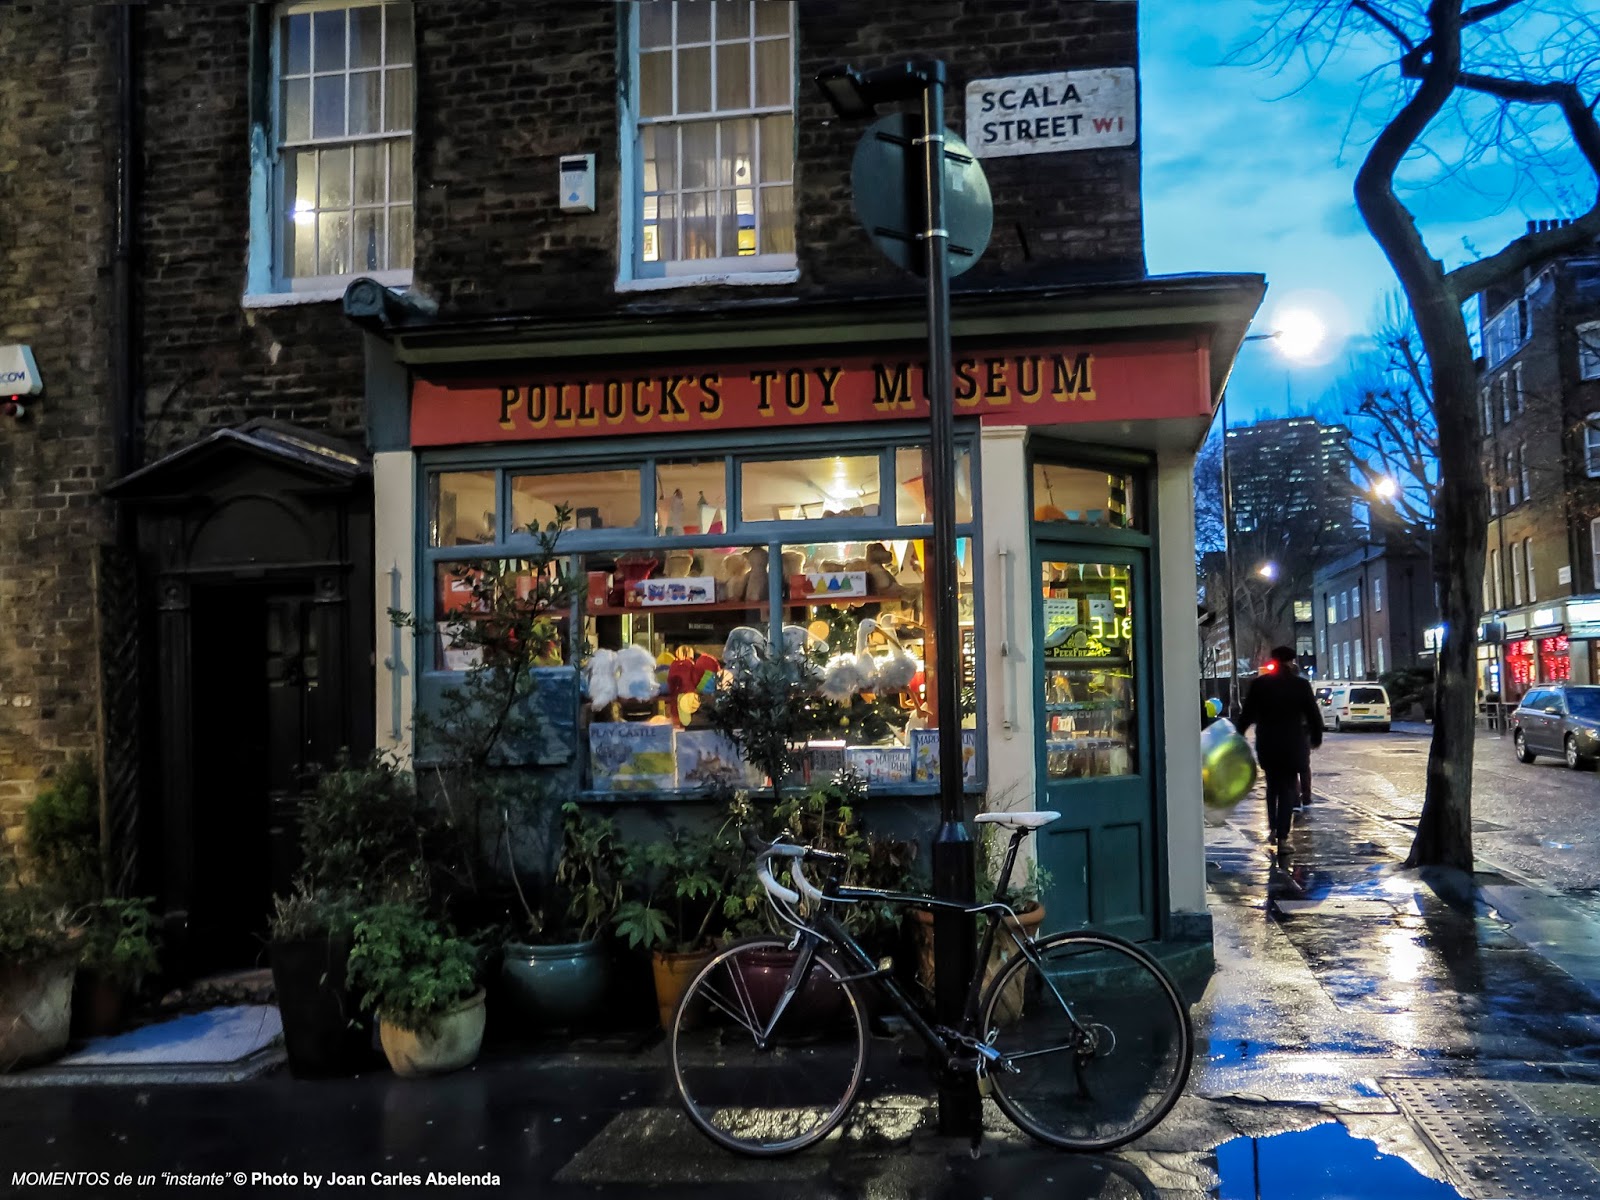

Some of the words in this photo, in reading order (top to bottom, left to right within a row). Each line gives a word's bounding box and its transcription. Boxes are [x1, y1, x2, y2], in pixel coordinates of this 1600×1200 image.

[981, 83, 1082, 112] SCALA
[983, 114, 1083, 143] STREET
[0, 371, 25, 382] COM
[498, 372, 723, 430] POLLOCK'S
[751, 367, 845, 417] TOY
[591, 729, 615, 739] PLAY
[618, 728, 657, 738] CASTLE
[875, 753, 907, 766] MARBLE
[891, 762, 908, 773] RUN
